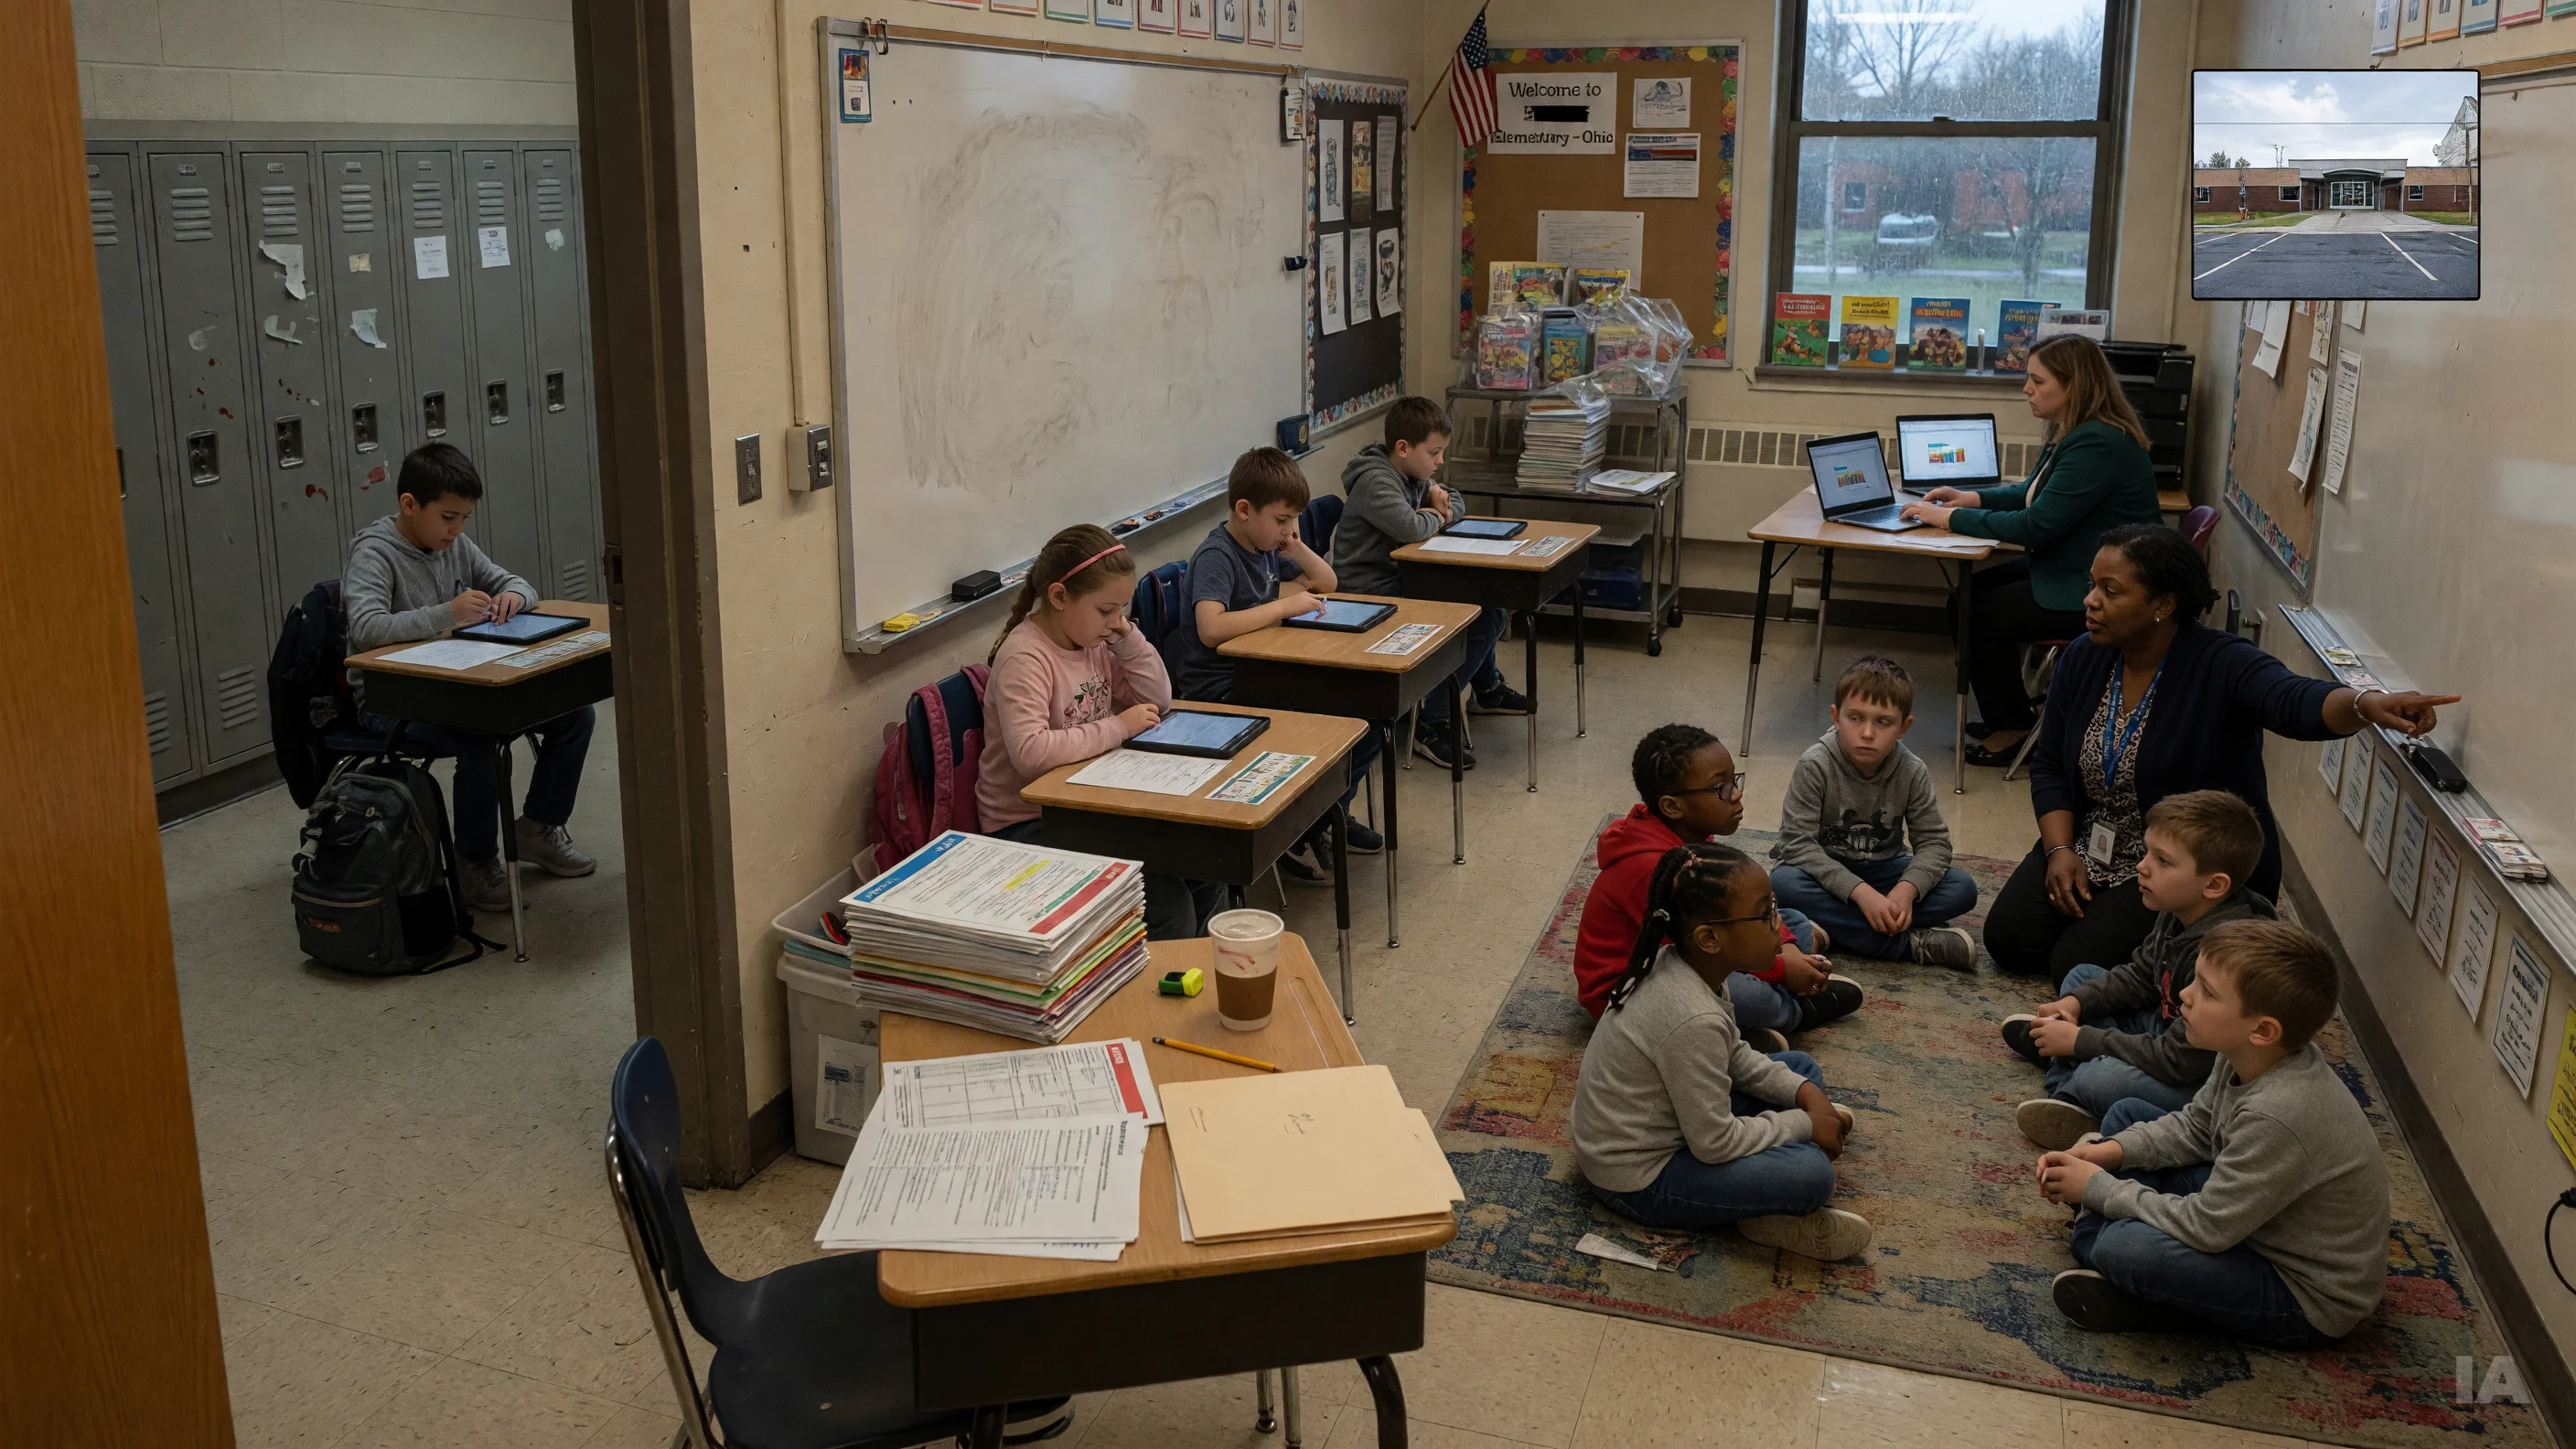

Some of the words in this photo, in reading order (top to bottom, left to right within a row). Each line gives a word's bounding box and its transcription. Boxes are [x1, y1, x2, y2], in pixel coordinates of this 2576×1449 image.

[1508, 81, 1581, 97] Welcome
[1585, 82, 1602, 97] to
[1583, 130, 1614, 144] Ohio
